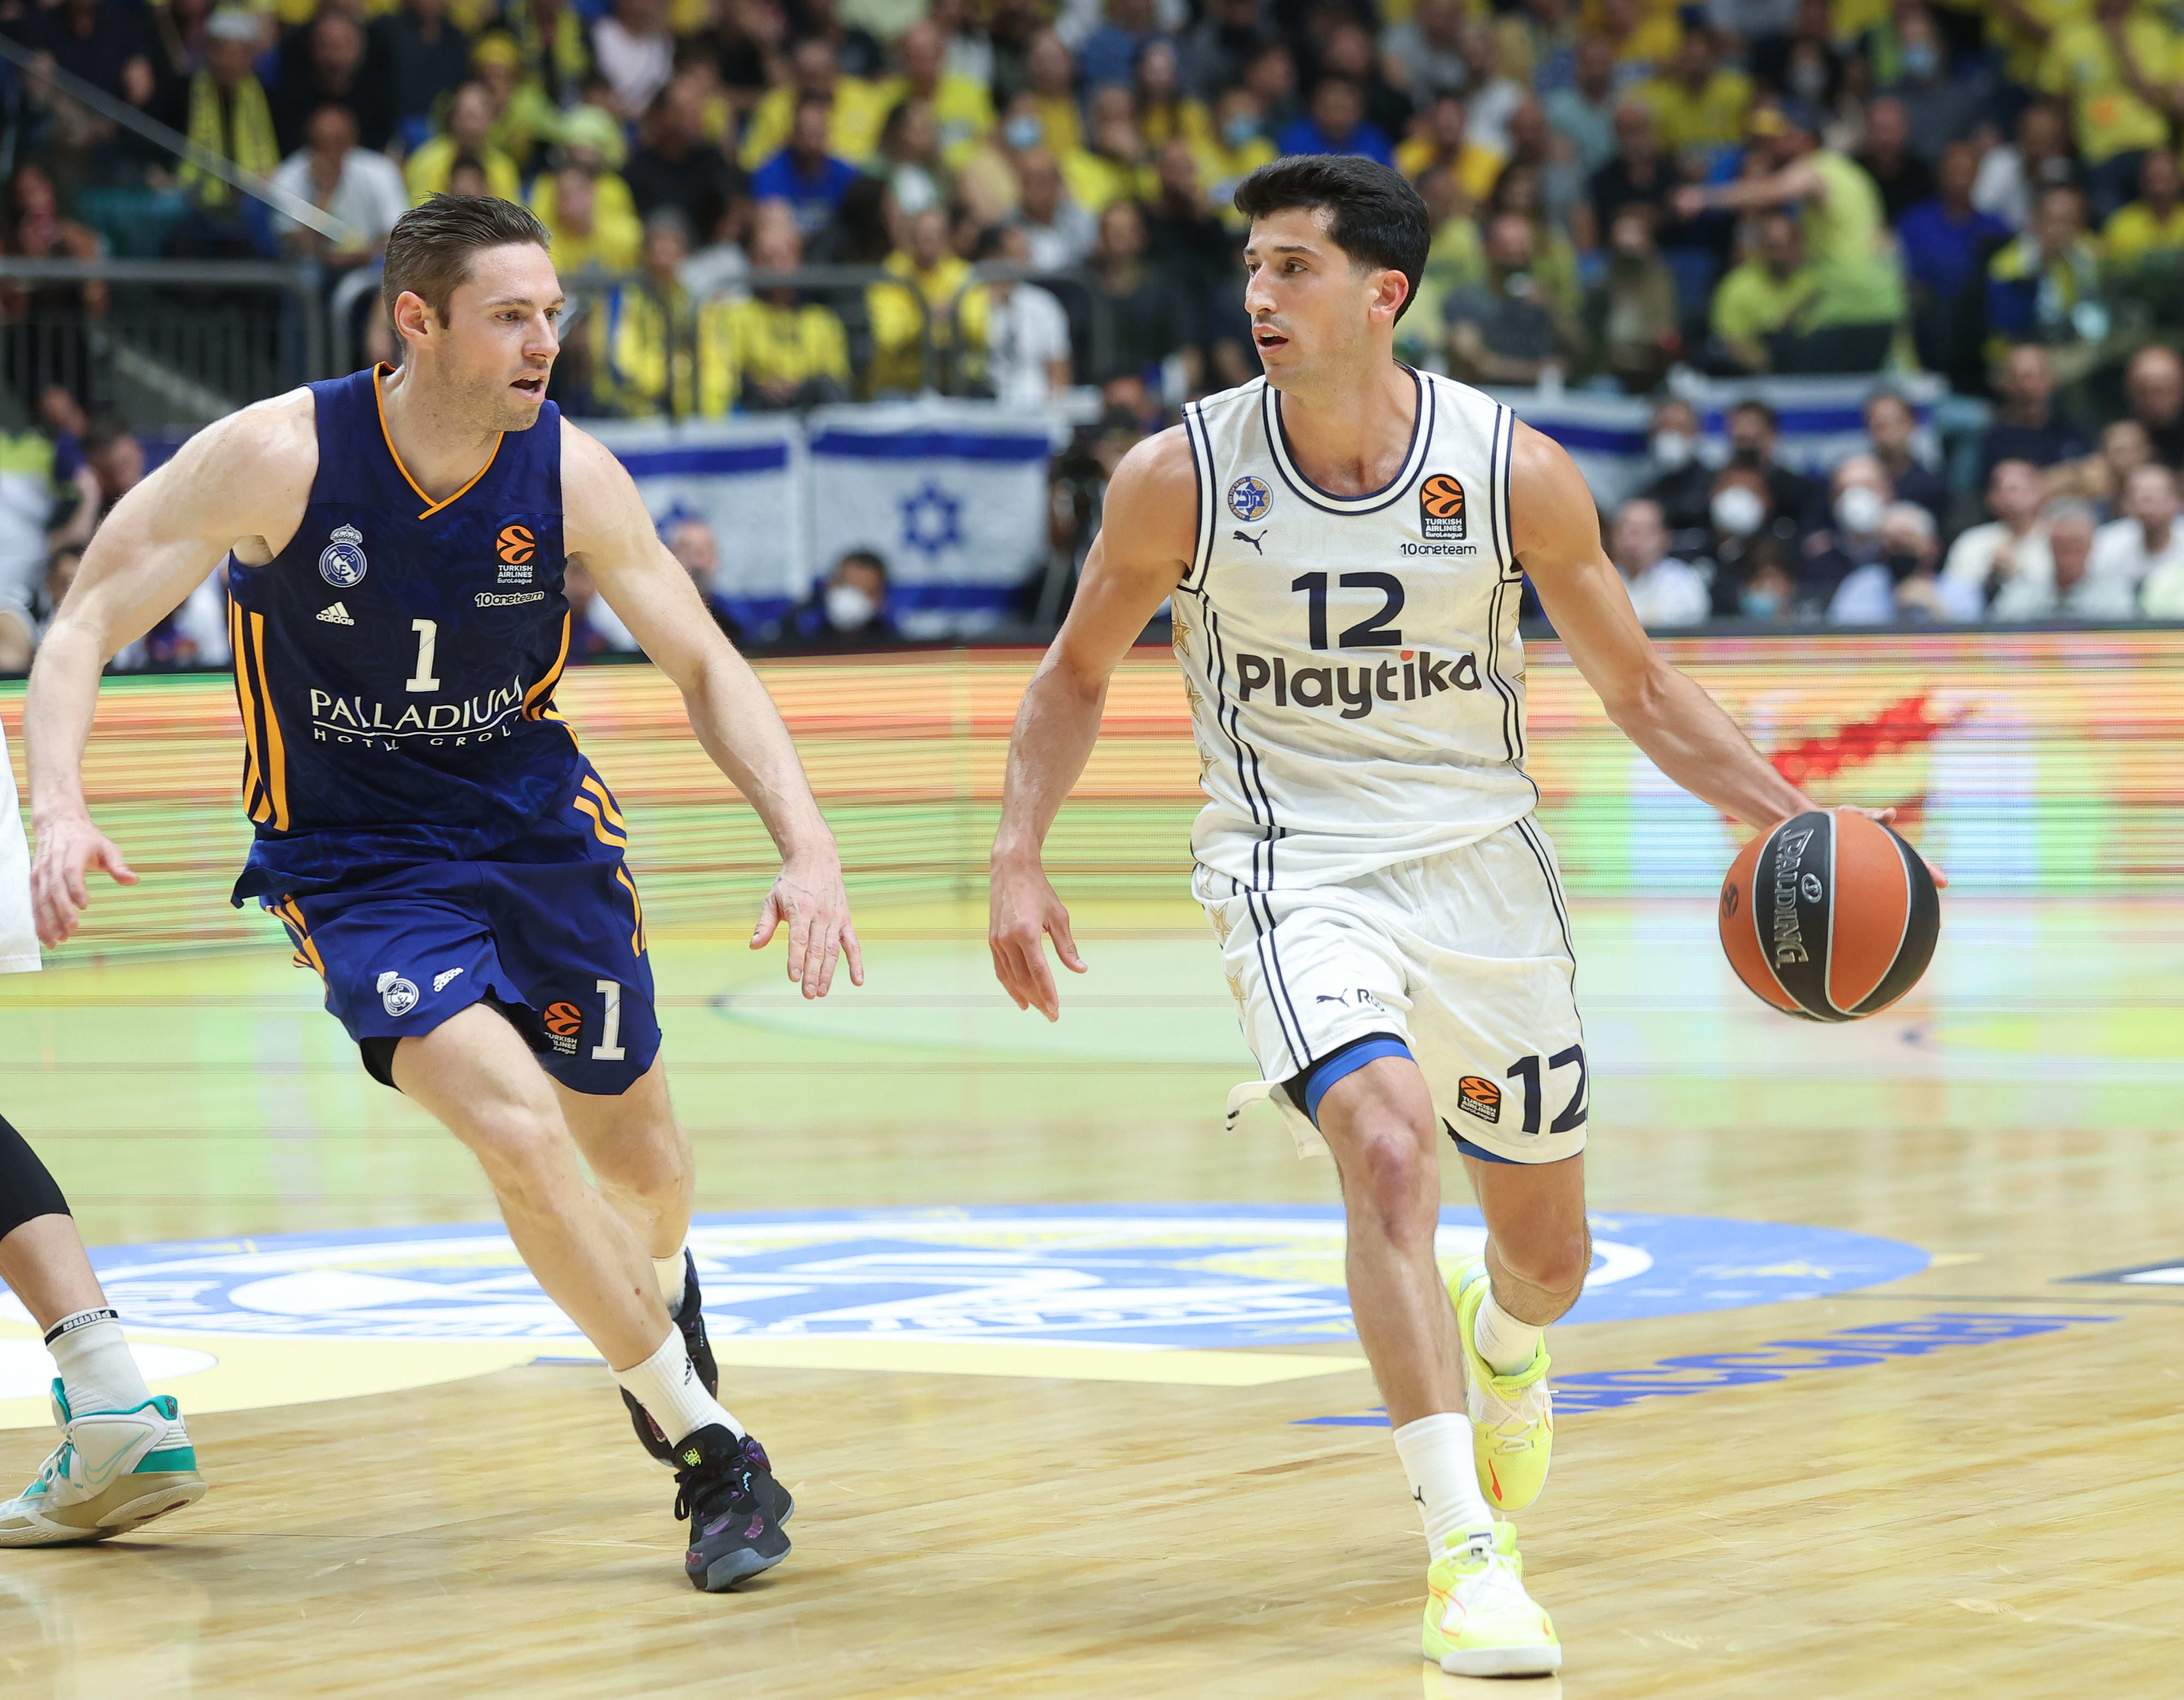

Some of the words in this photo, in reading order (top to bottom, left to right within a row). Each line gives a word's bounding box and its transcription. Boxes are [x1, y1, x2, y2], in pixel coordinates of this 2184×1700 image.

[316, 613, 355, 626] adidas
[1292, 572, 1405, 650] 12
[406, 619, 440, 692] 1
[1237, 650, 1482, 719] Playtika
[310, 674, 523, 730] PALLADIUM
[1773, 828, 1814, 969] SPALDING
[553, 1040, 577, 1050] LINES
[591, 979, 625, 1061] 1
[1462, 1095, 1496, 1112] TURKISH
[1462, 1100, 1496, 1117] AIRLINES
[1507, 1044, 1587, 1134] 12
